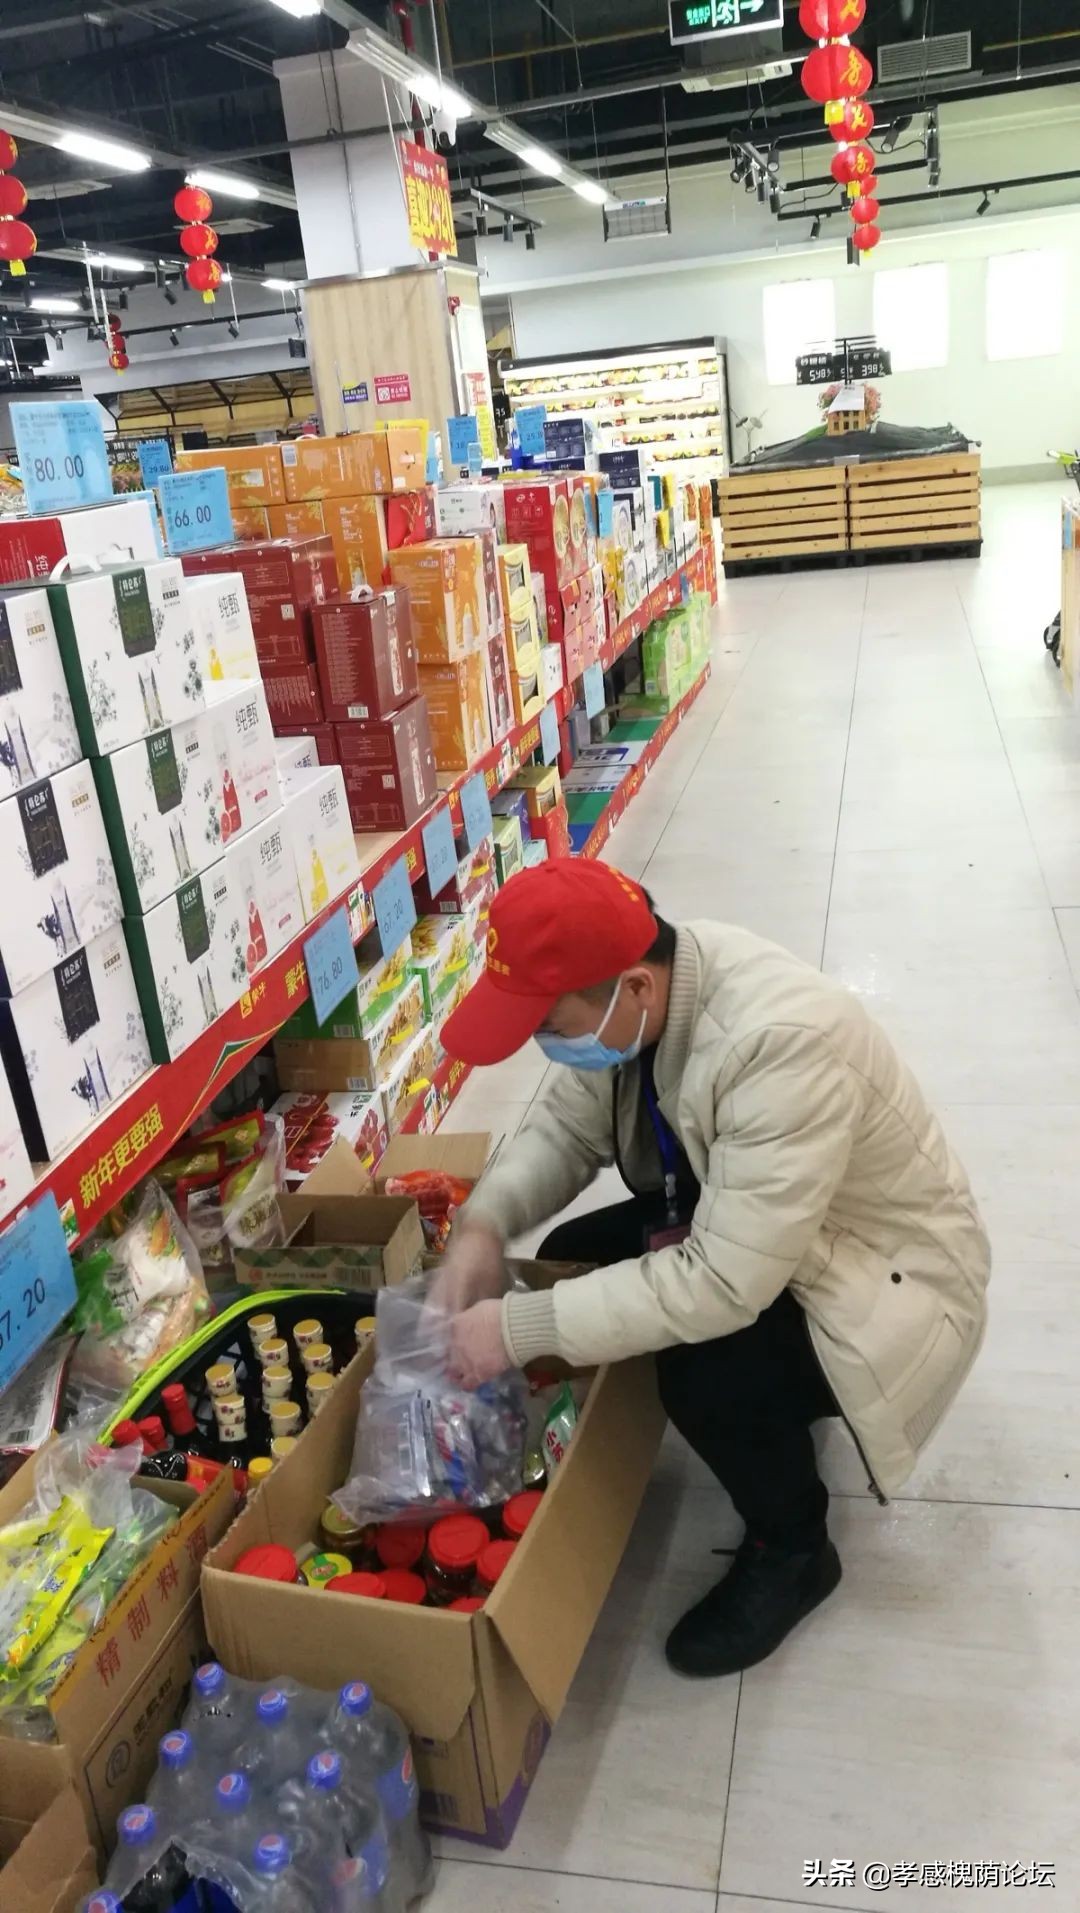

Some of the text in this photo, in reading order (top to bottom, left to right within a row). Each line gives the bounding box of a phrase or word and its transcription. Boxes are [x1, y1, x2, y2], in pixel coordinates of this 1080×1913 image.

[34, 455, 85, 482] 80.00
[174, 504, 212, 528] 66.00
[284, 960, 307, 999] 蒙牛
[317, 956, 343, 996] 76.80
[79, 1102, 164, 1209] 新年更要强
